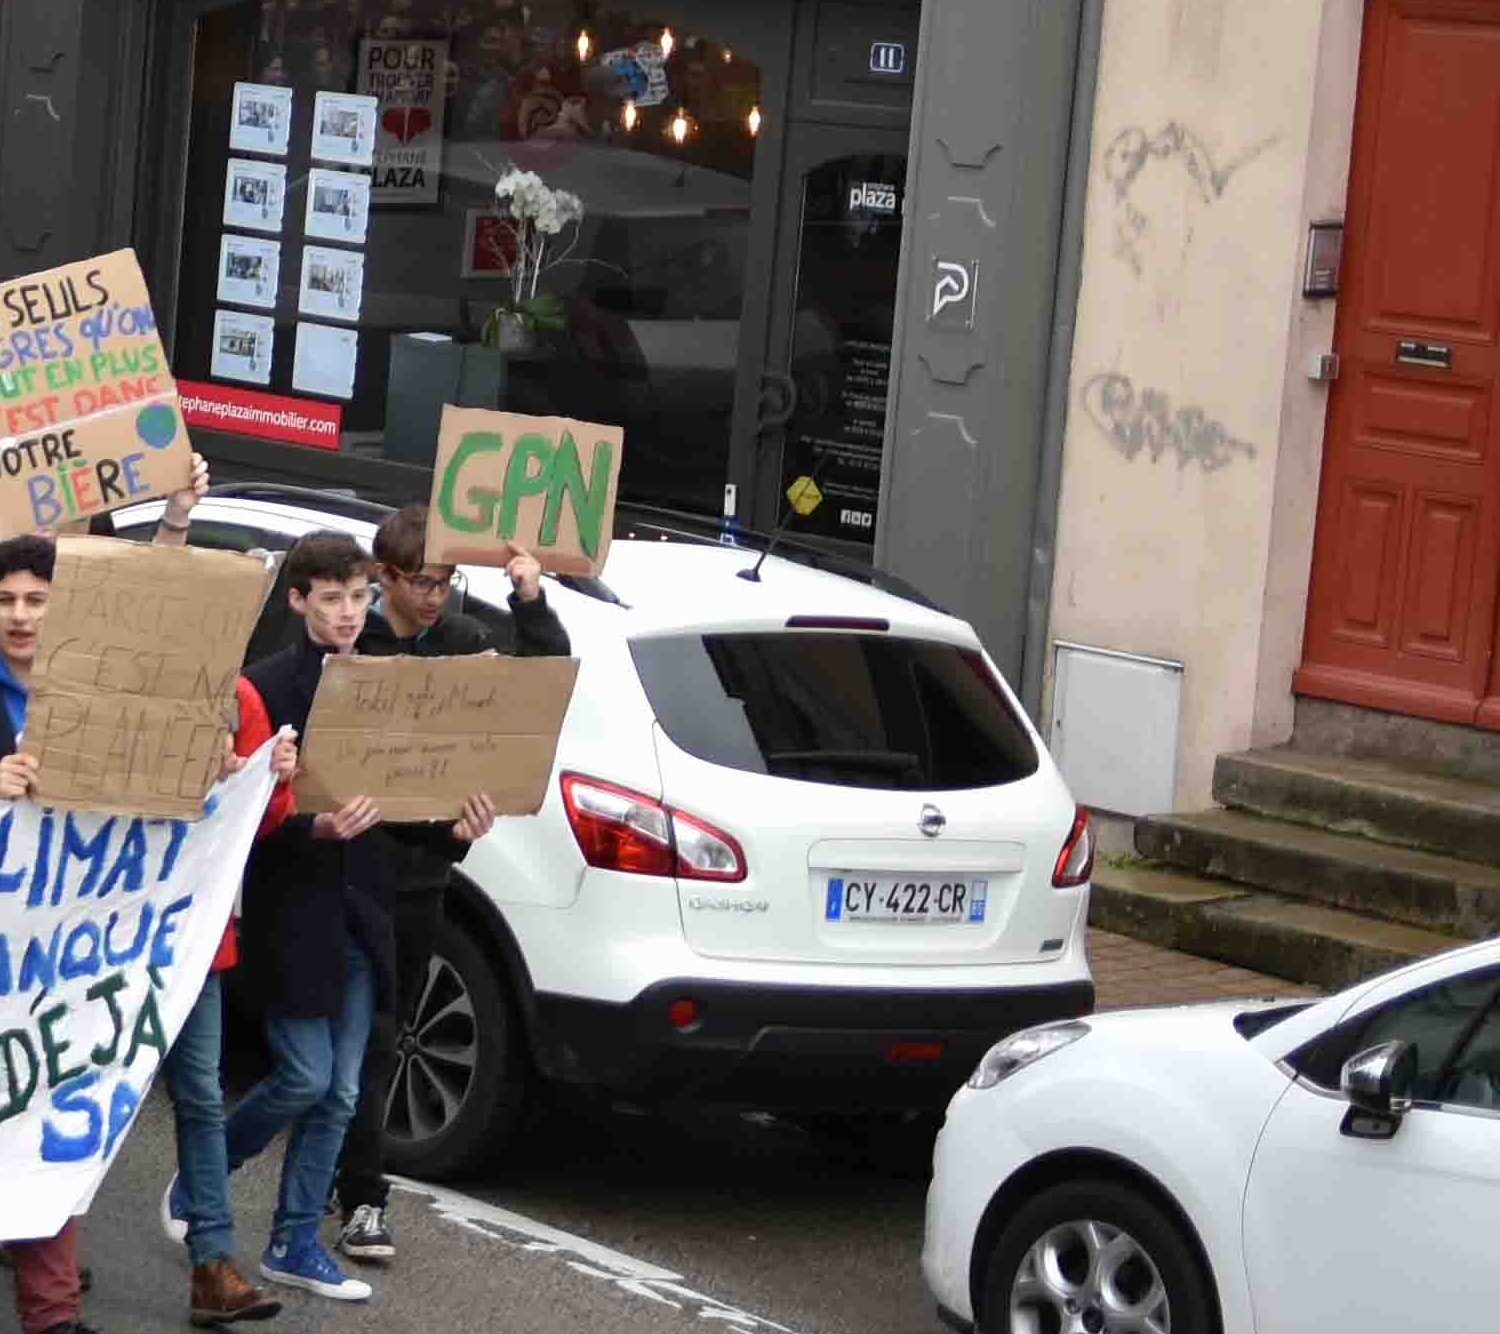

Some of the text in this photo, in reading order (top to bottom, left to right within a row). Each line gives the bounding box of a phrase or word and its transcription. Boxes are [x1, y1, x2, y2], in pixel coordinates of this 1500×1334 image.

[879, 47, 896, 68] 11
[849, 181, 897, 211] plaza
[3, 270, 111, 329] SEULS
[42, 356, 87, 390] EN
[89, 343, 159, 381] PLUS
[178, 394, 337, 437] tephaneplazaimmobilier.com
[438, 430, 614, 557] GPN
